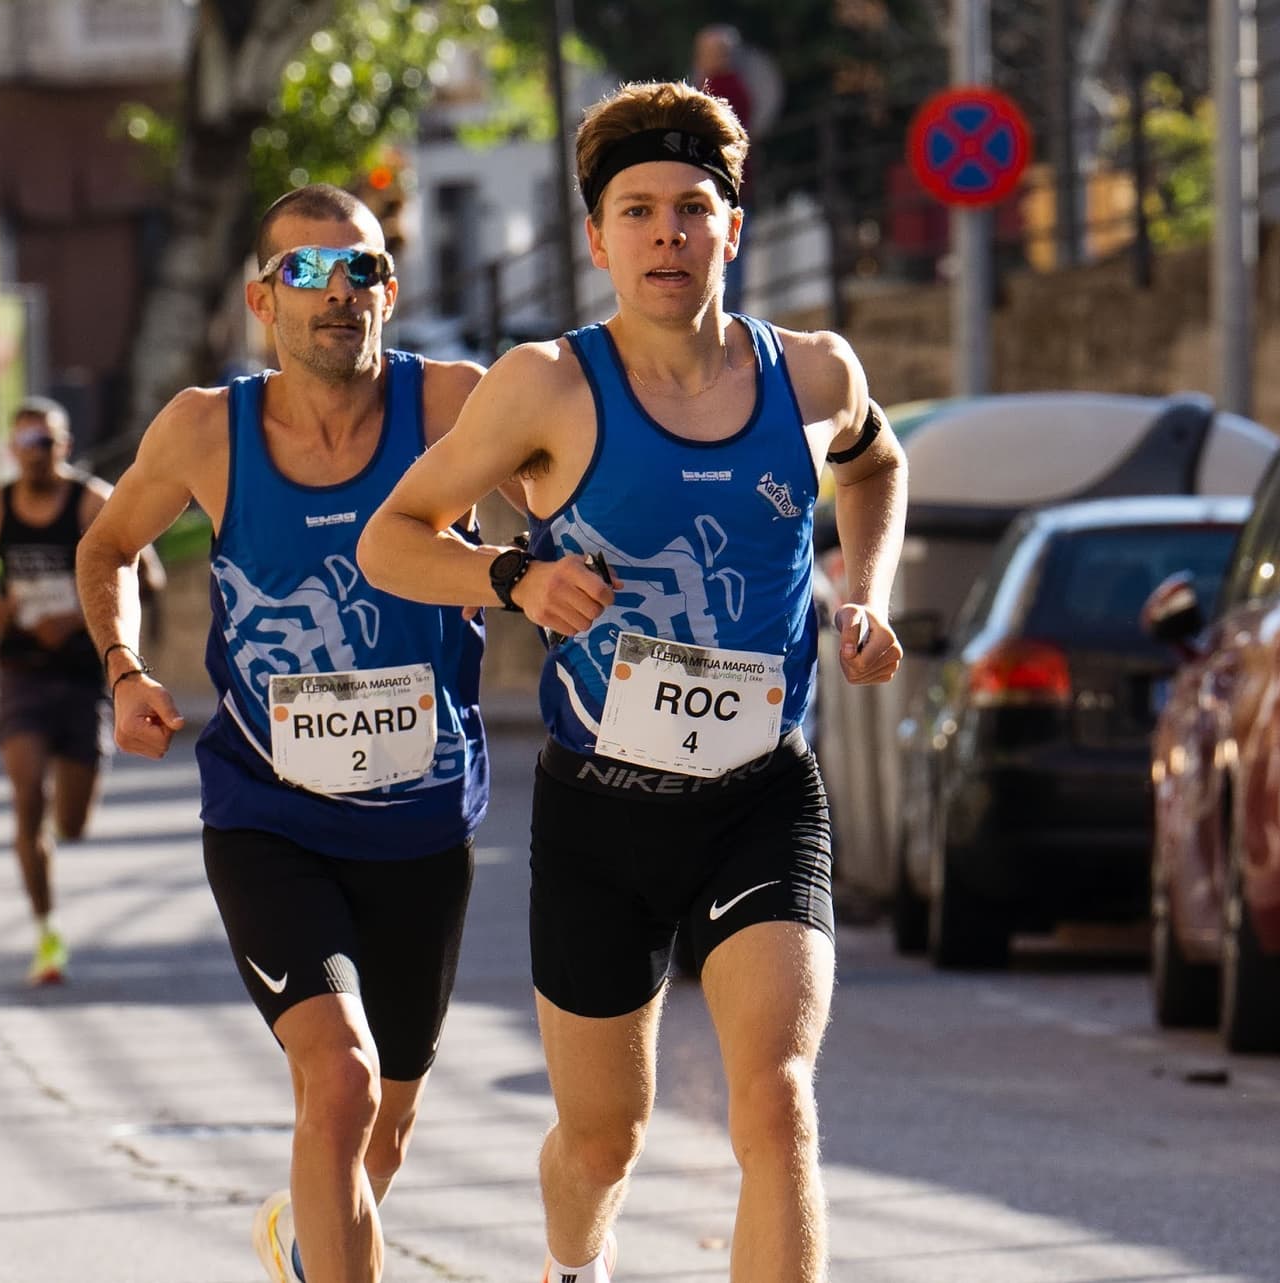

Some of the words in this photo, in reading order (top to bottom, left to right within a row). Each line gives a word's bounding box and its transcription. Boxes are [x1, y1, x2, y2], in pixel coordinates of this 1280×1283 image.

[689, 656, 721, 669] MITJA
[722, 660, 765, 675] MARATÓ
[336, 678, 368, 692] MITJA
[370, 676, 411, 689] MARATÓ
[654, 681, 741, 721] ROC
[293, 706, 417, 739] RICARD
[682, 731, 699, 754] 4
[352, 750, 367, 771] 2
[576, 760, 689, 794] NIKE
